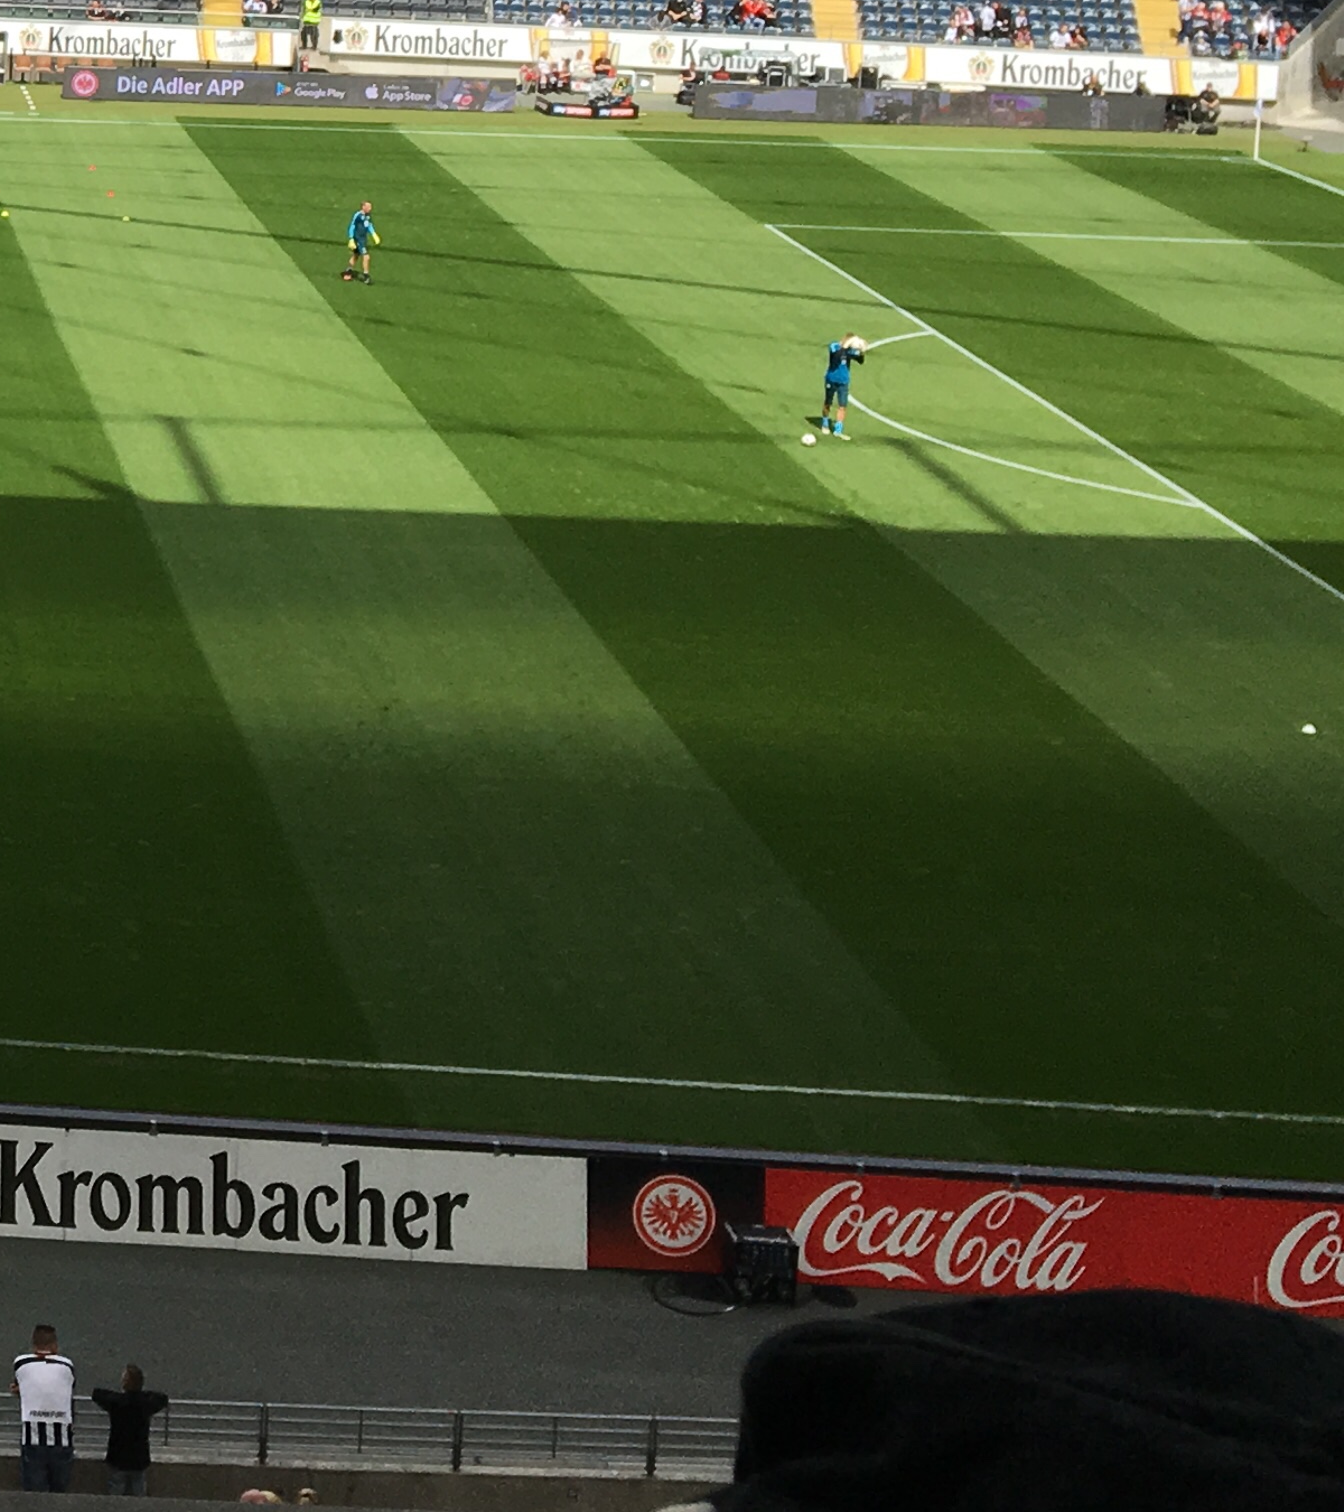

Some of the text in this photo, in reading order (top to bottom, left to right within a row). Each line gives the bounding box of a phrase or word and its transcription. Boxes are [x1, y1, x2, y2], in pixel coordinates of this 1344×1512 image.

[49, 26, 176, 60] Krombacher
[374, 26, 509, 59] Krombacher
[117, 76, 245, 97] Die Adler APP
[796, 1179, 1106, 1293] Coca-Cola
